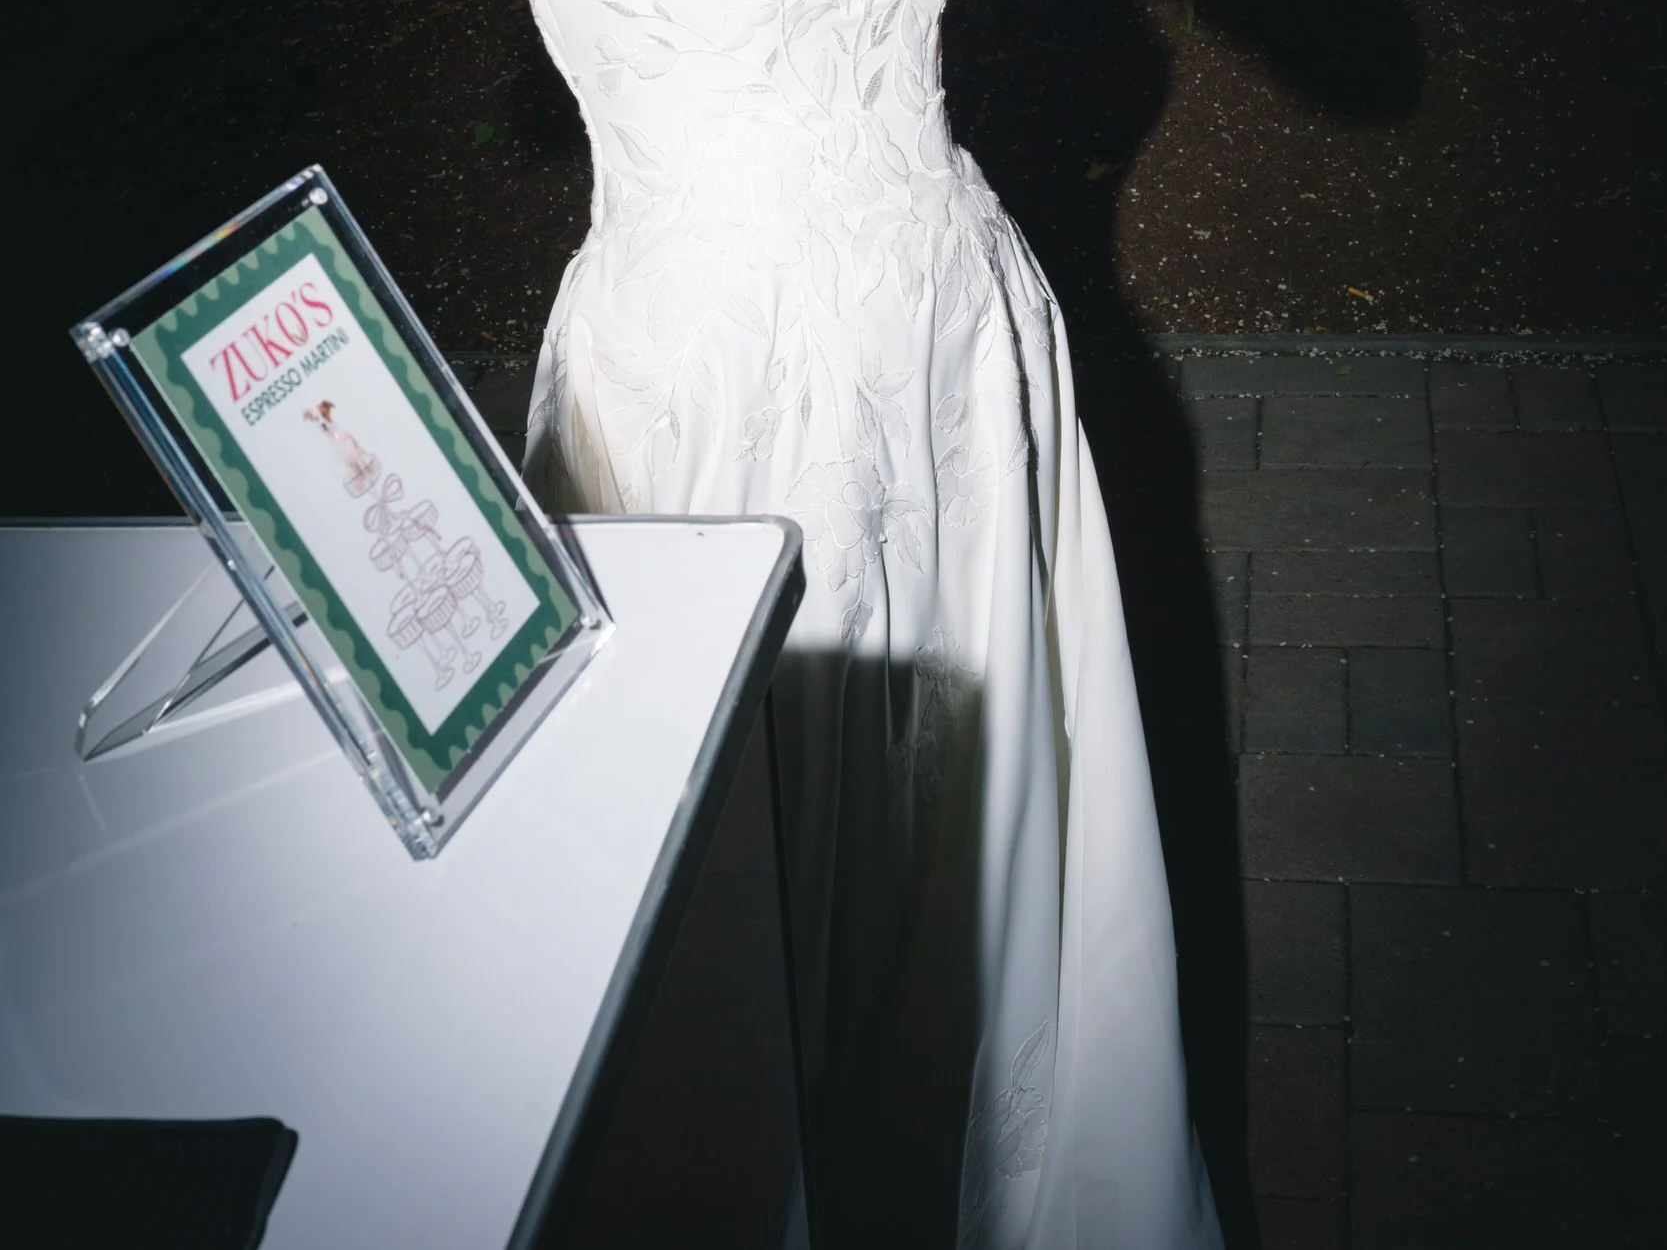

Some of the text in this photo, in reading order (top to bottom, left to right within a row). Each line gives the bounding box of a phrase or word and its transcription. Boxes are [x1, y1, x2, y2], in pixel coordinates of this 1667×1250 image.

[209, 282, 333, 402] ZUKO'S
[241, 327, 350, 426] ESPRESSO MARTINI
